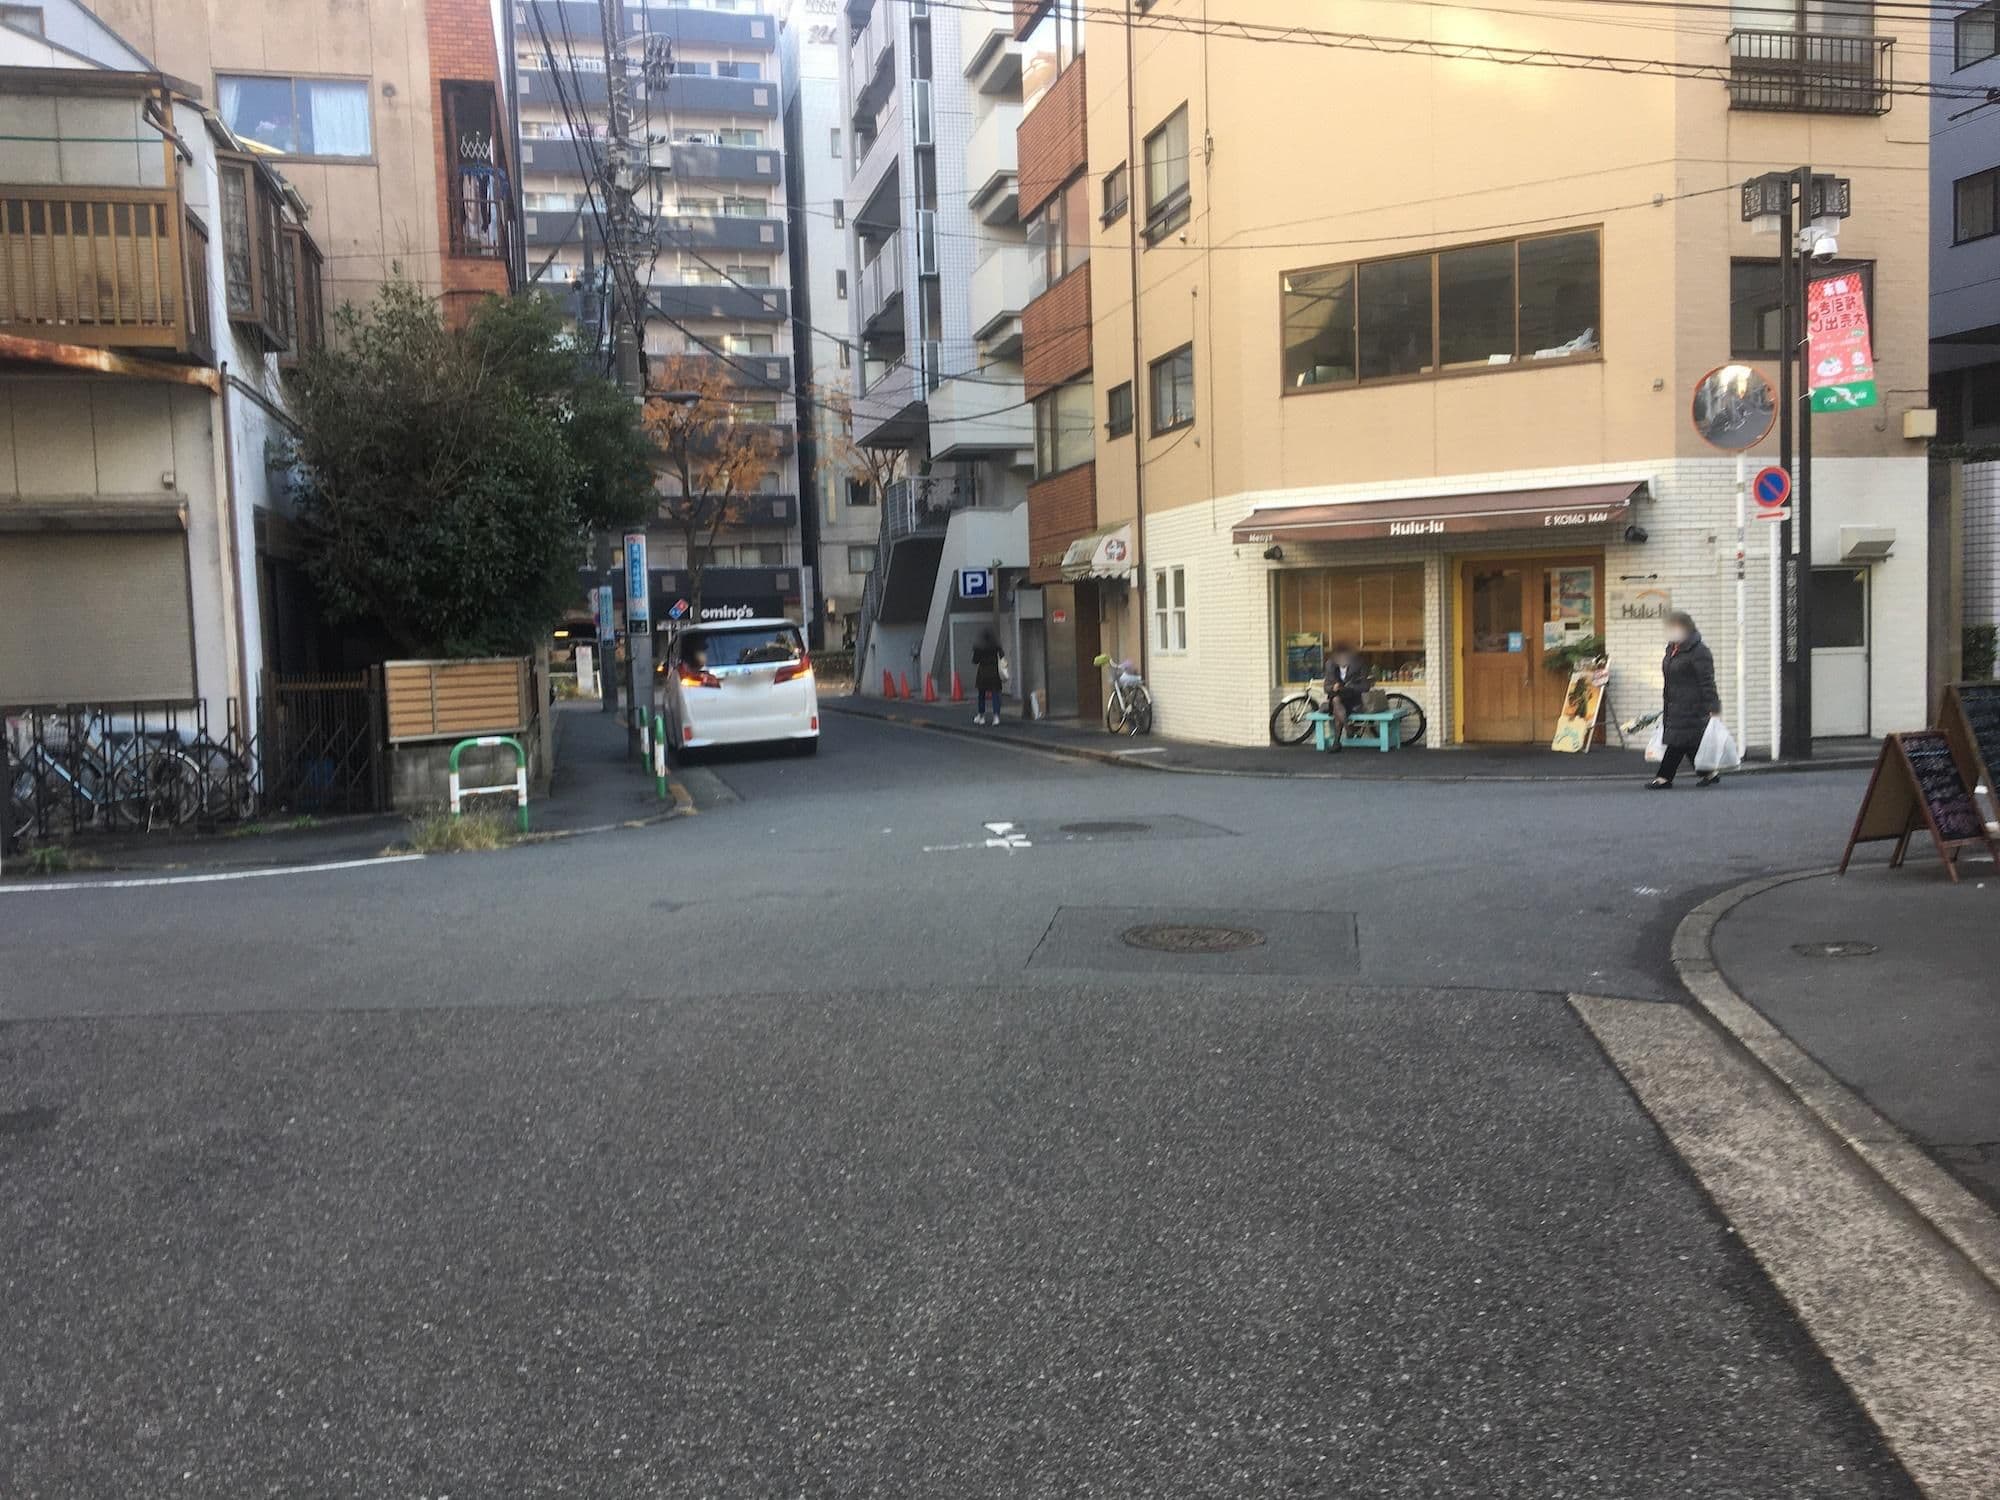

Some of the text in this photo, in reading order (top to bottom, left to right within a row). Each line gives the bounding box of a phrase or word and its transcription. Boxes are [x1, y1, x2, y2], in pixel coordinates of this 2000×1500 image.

[1544, 512, 1609, 526] E KOMO MAI
[1390, 520, 1445, 536] Hulu-lu
[966, 573, 984, 594] P
[689, 604, 754, 619] omino's
